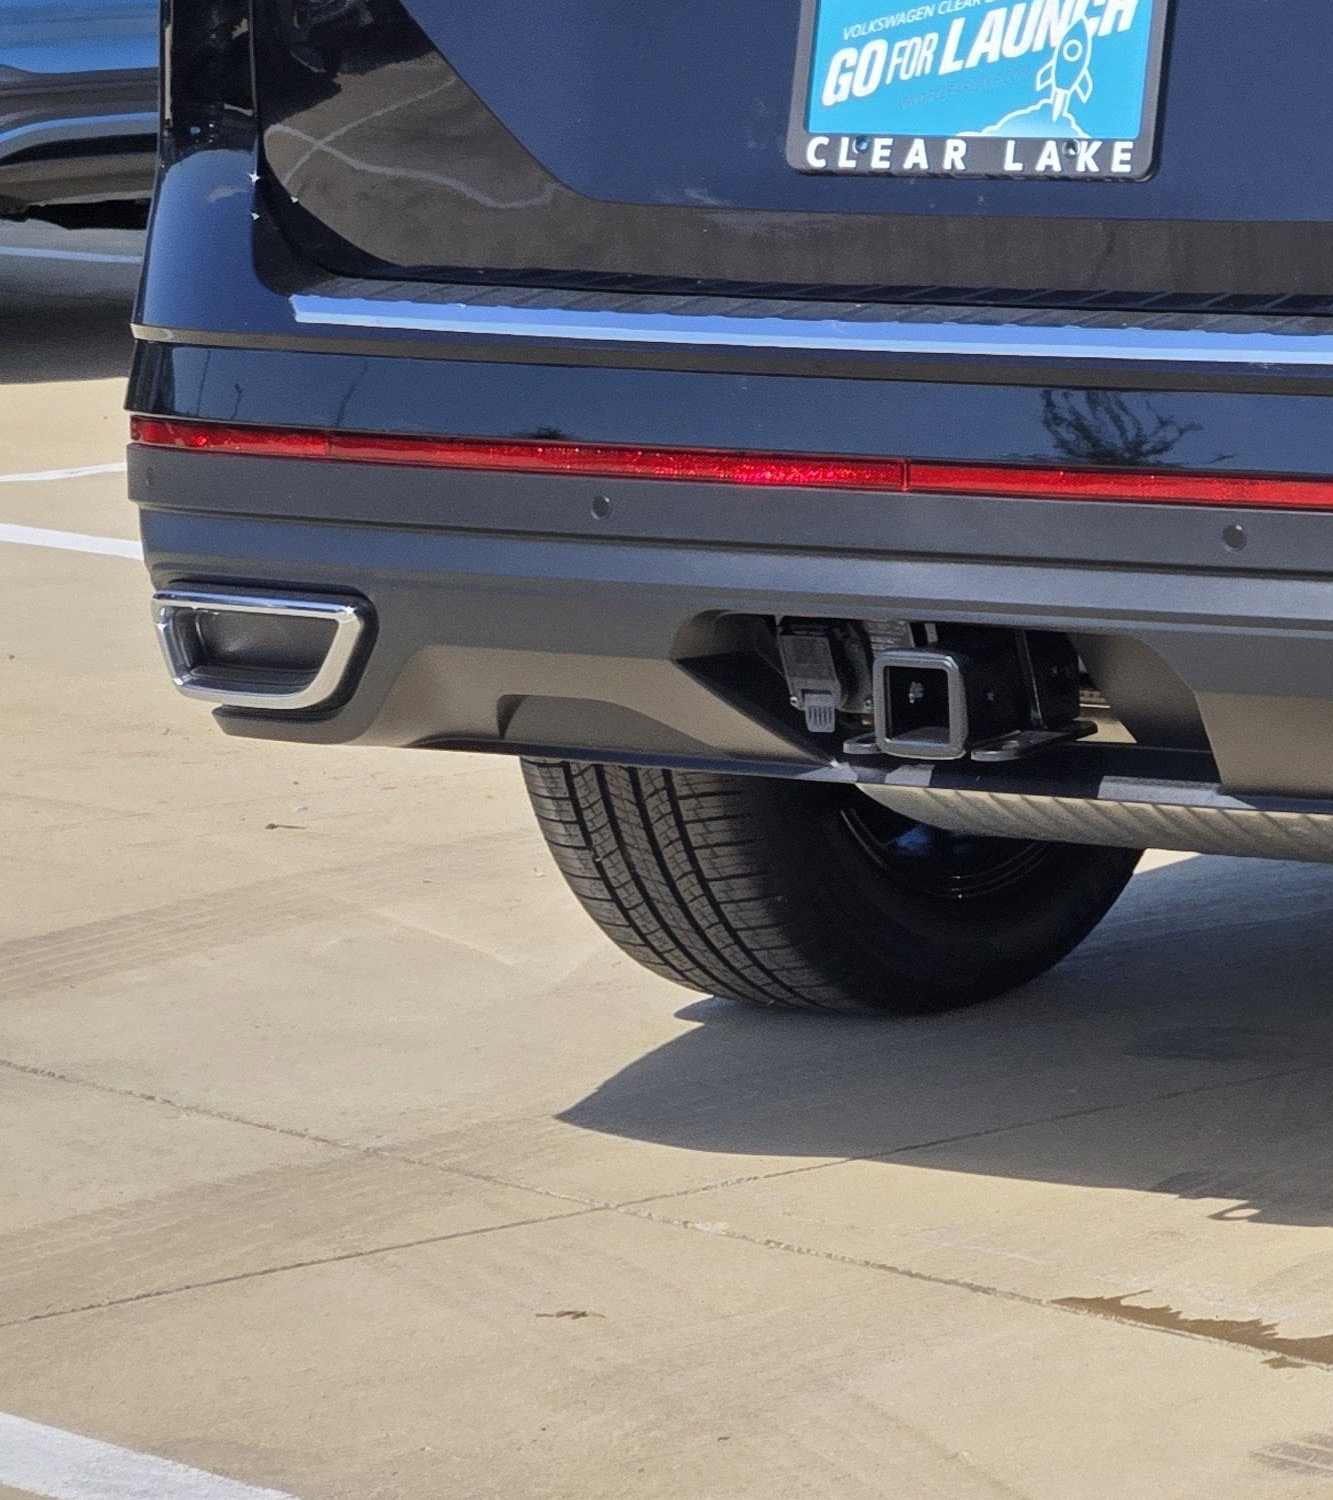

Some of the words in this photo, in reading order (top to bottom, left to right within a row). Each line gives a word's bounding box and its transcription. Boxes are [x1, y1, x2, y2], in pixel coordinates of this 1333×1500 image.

[842, 4, 935, 41] VOLKSWAGEN
[821, 38, 889, 108] GO
[885, 31, 939, 86] FOR
[806, 135, 968, 171] CLEAR
[1004, 139, 1134, 174] LAKE
